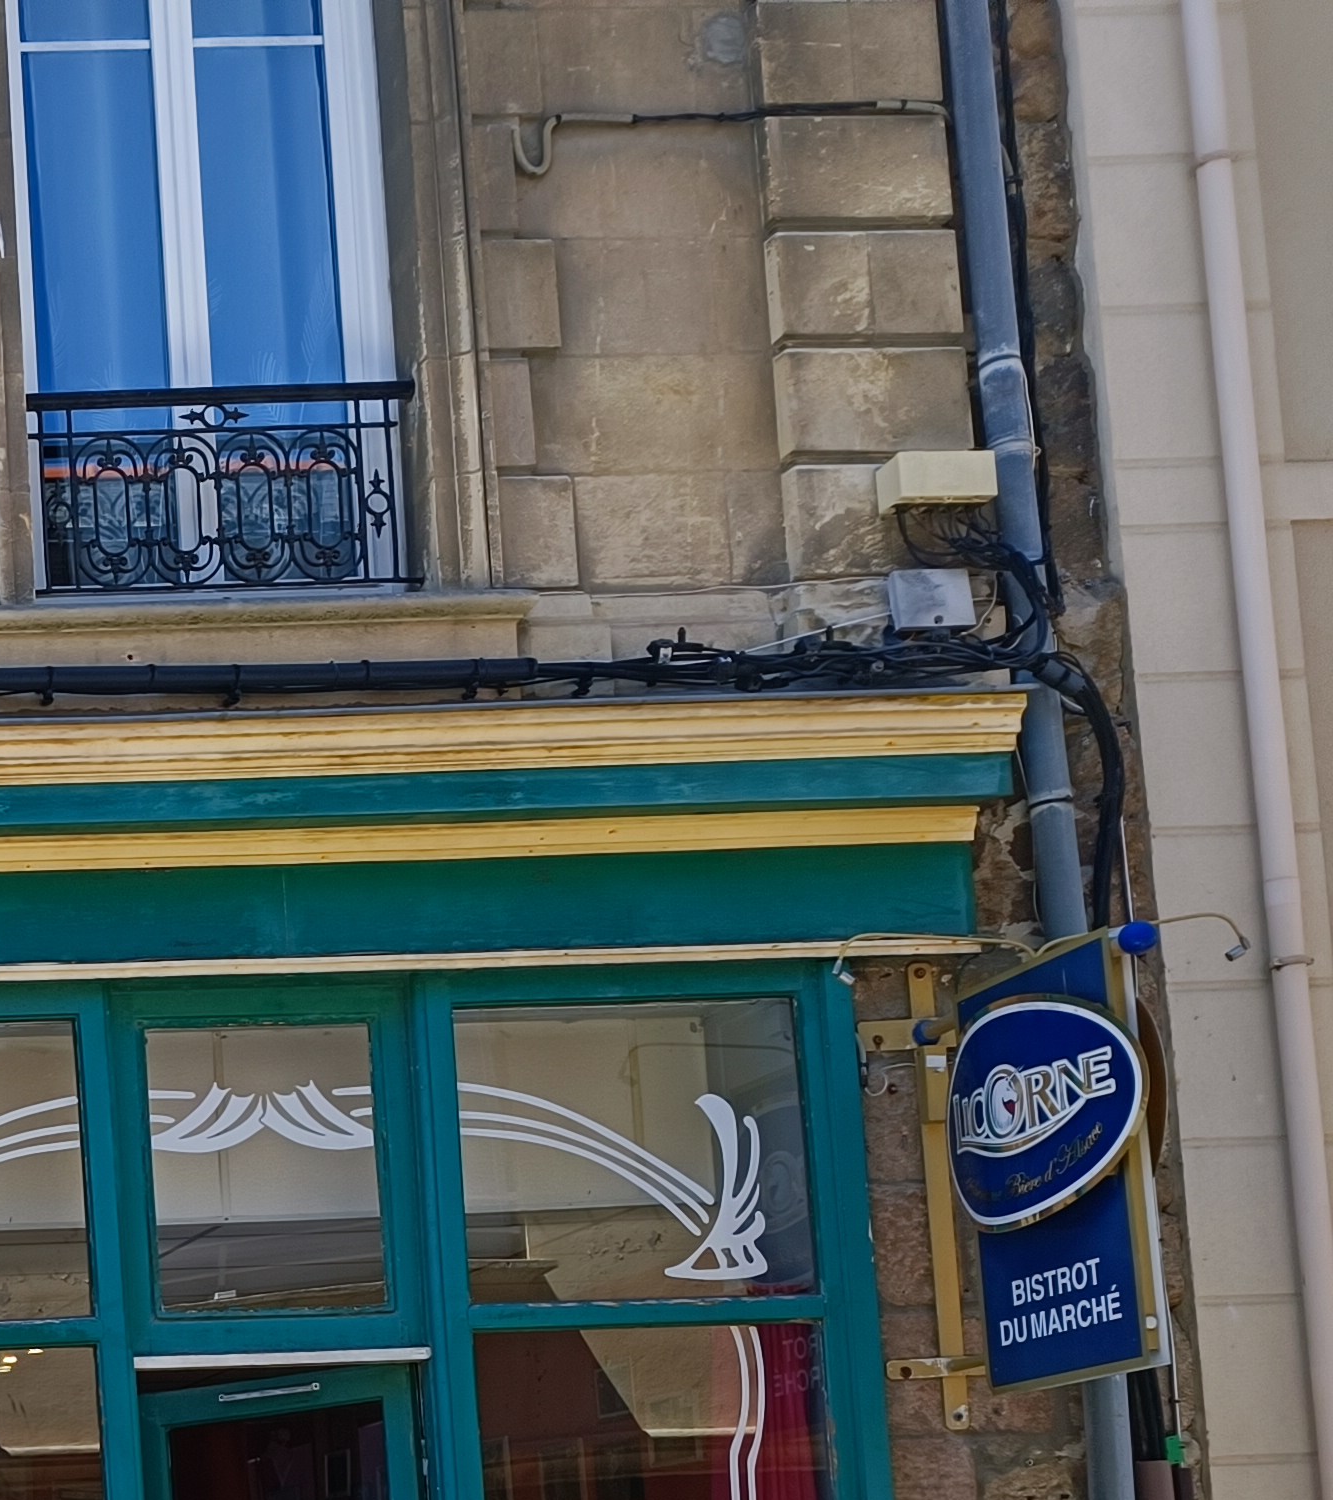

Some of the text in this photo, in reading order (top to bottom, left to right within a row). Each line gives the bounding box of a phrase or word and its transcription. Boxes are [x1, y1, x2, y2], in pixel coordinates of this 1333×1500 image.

[1012, 1258, 1100, 1306] BISTROT
[1000, 1284, 1123, 1346] DU MARCHÉ
